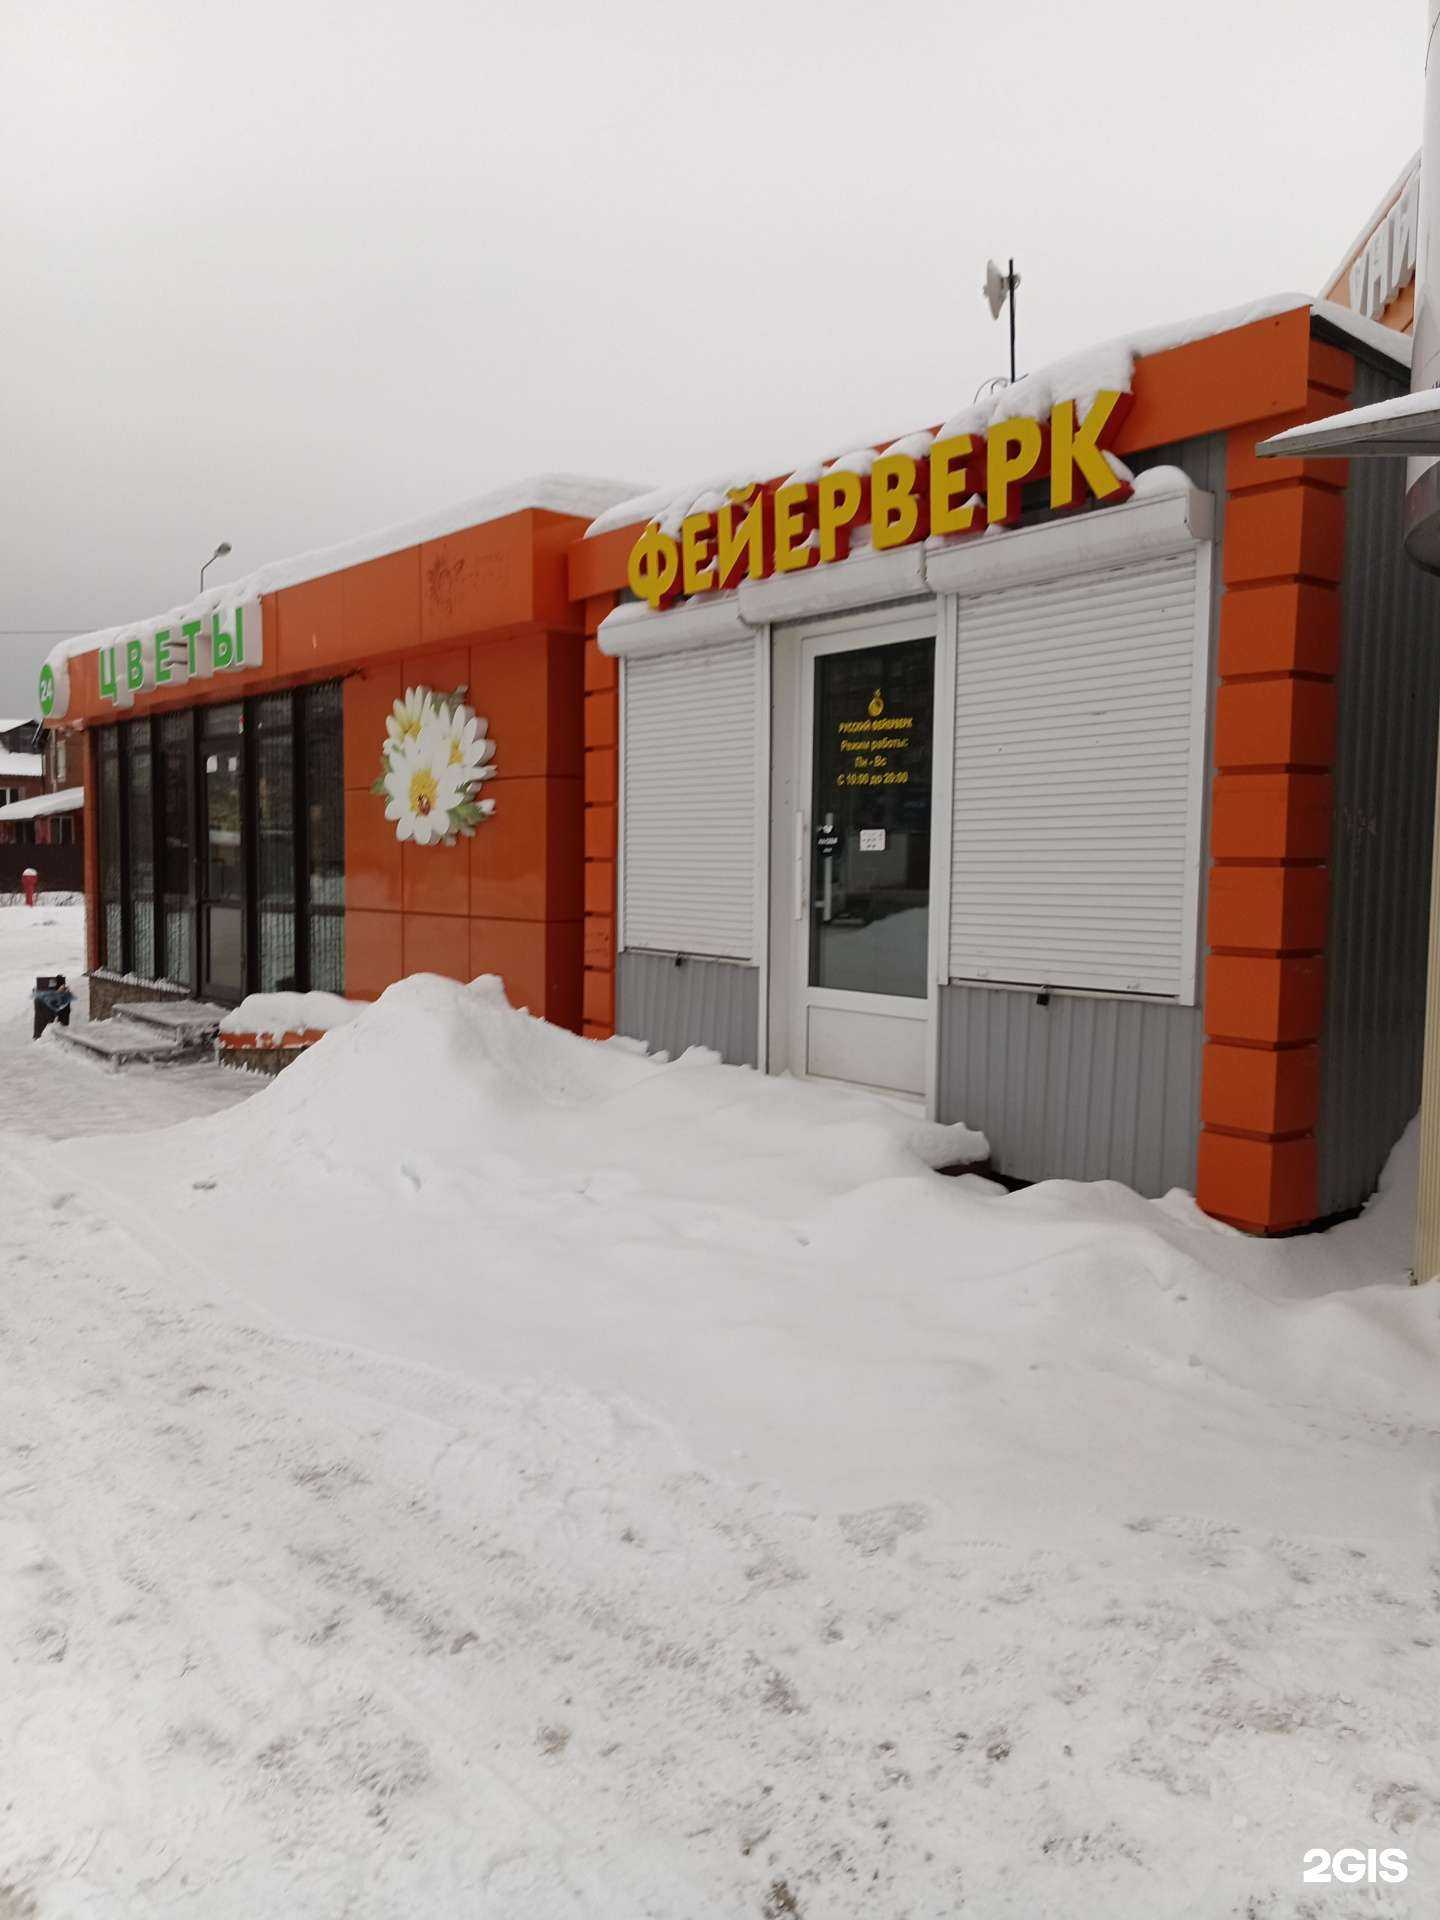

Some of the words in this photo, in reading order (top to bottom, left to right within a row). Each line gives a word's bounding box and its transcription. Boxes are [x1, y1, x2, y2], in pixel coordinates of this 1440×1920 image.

[627, 391, 1130, 611] ФЕЙЕРВЕРК
[99, 606, 244, 703] ЦВЕТЫ
[840, 740, 870, 752] Режим
[869, 775, 882, 785] до
